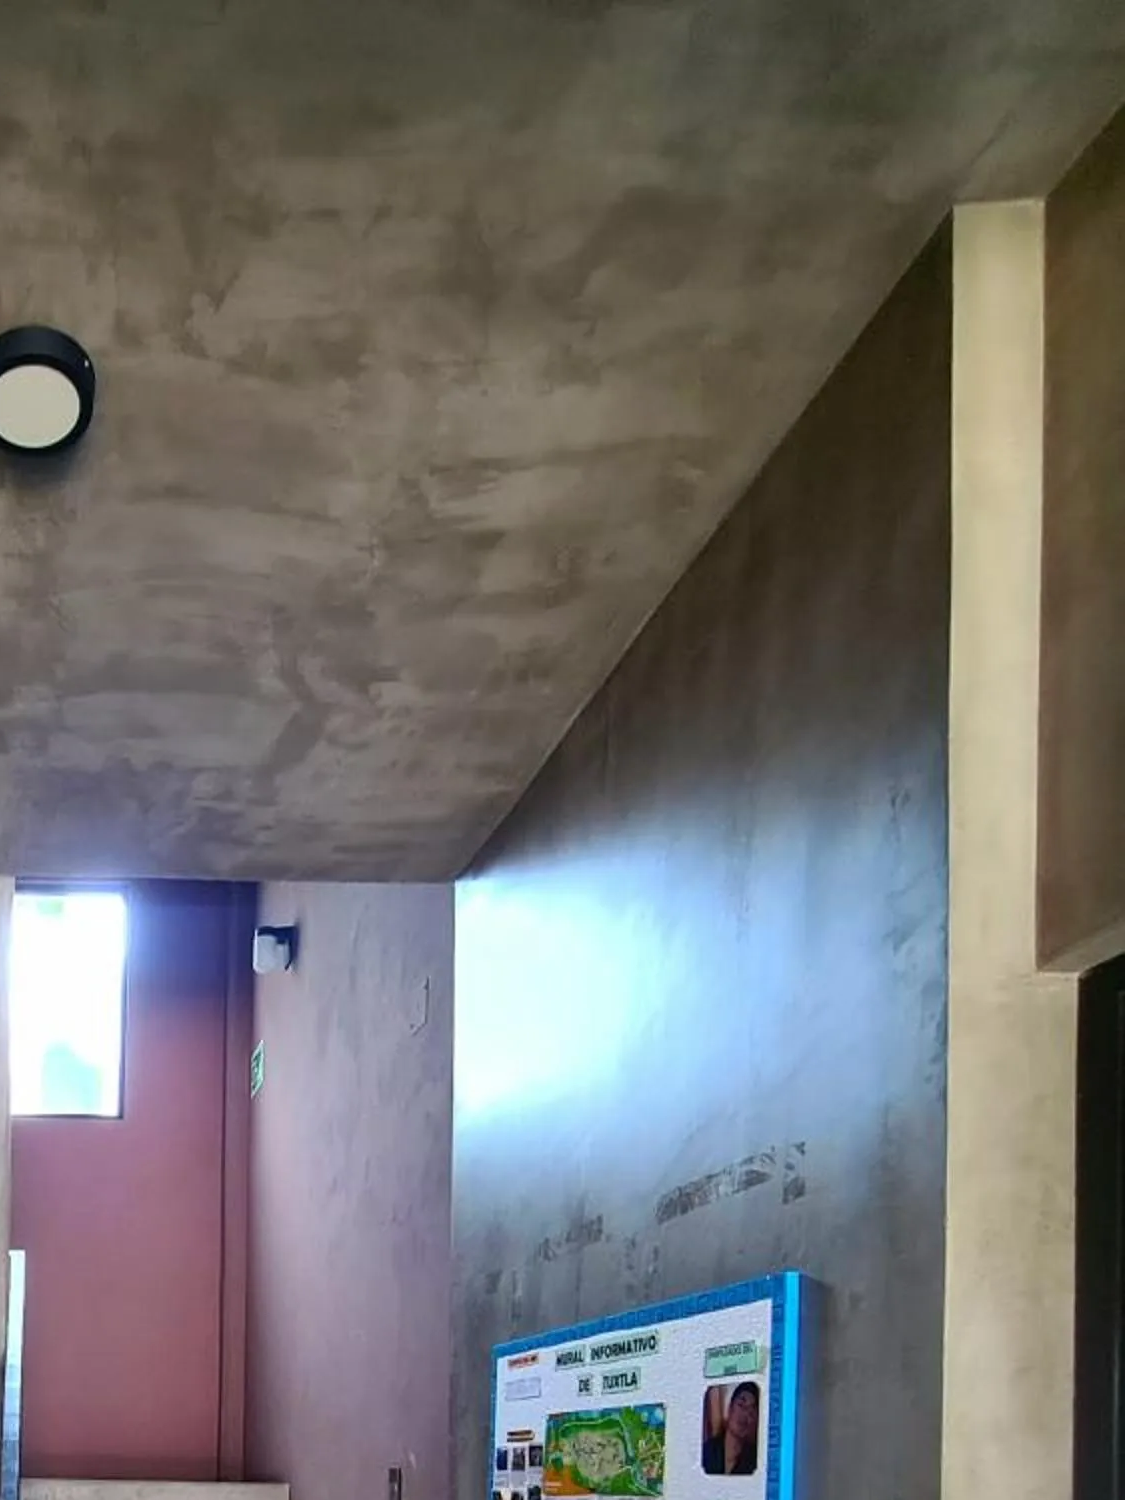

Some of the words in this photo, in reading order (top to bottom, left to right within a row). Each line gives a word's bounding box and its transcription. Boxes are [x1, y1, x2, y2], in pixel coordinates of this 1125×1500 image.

[590, 1335, 656, 1361] INFORMATIVO
[578, 1379, 591, 1393] DE
[602, 1371, 638, 1390] TUXTLA
